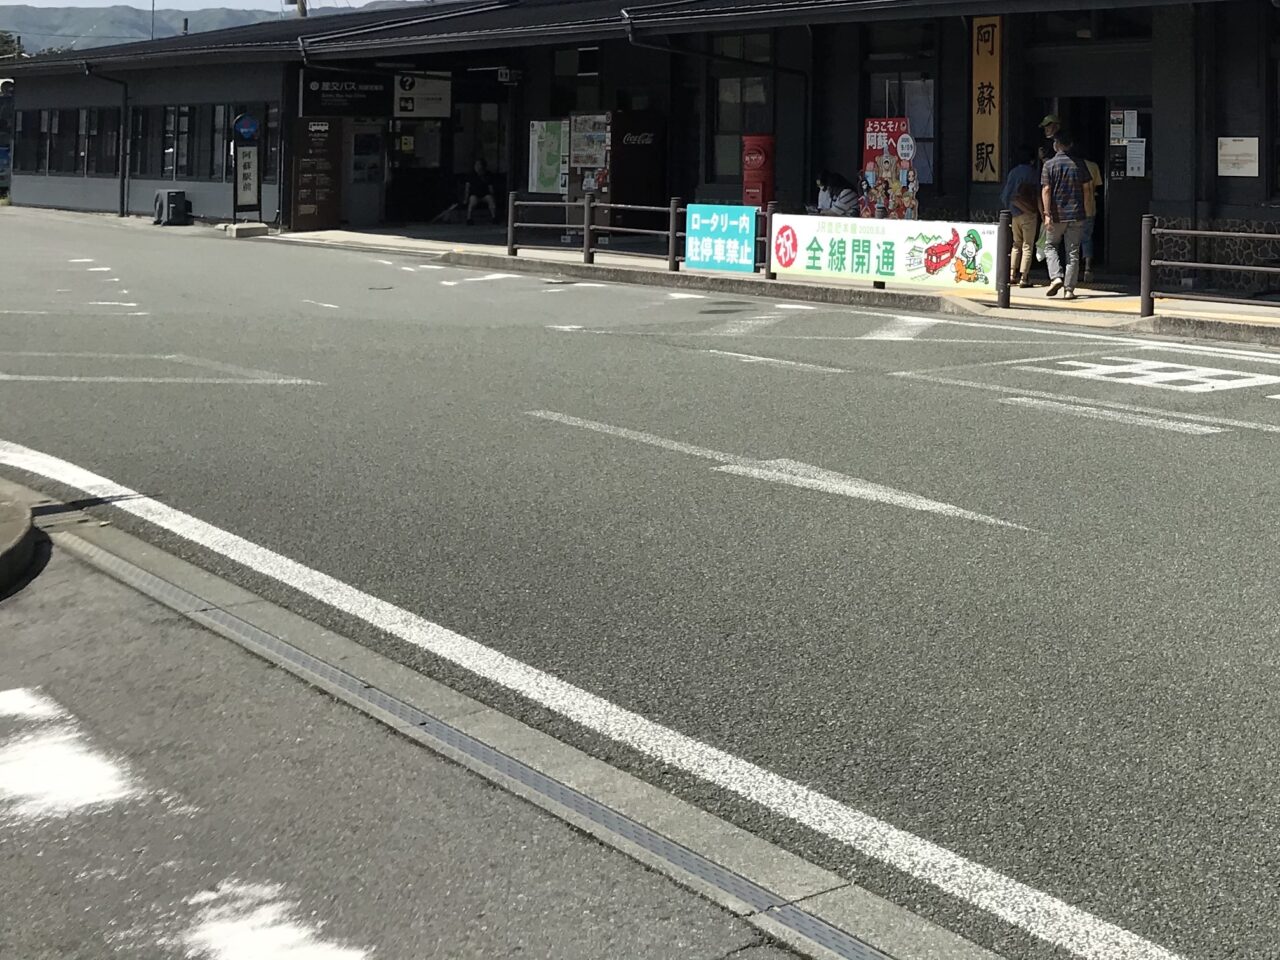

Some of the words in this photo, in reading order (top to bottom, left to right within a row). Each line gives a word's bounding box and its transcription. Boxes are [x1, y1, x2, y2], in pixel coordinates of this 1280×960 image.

[975, 23, 998, 174] 阿蘇駅
[866, 121, 898, 132] ようこそ!
[866, 132, 897, 150] 阿蘇へ
[691, 213, 750, 234] ロータリー内
[687, 236, 753, 265] 駐停車禁止
[777, 228, 797, 264] 祝
[805, 236, 896, 277] 全線開通
